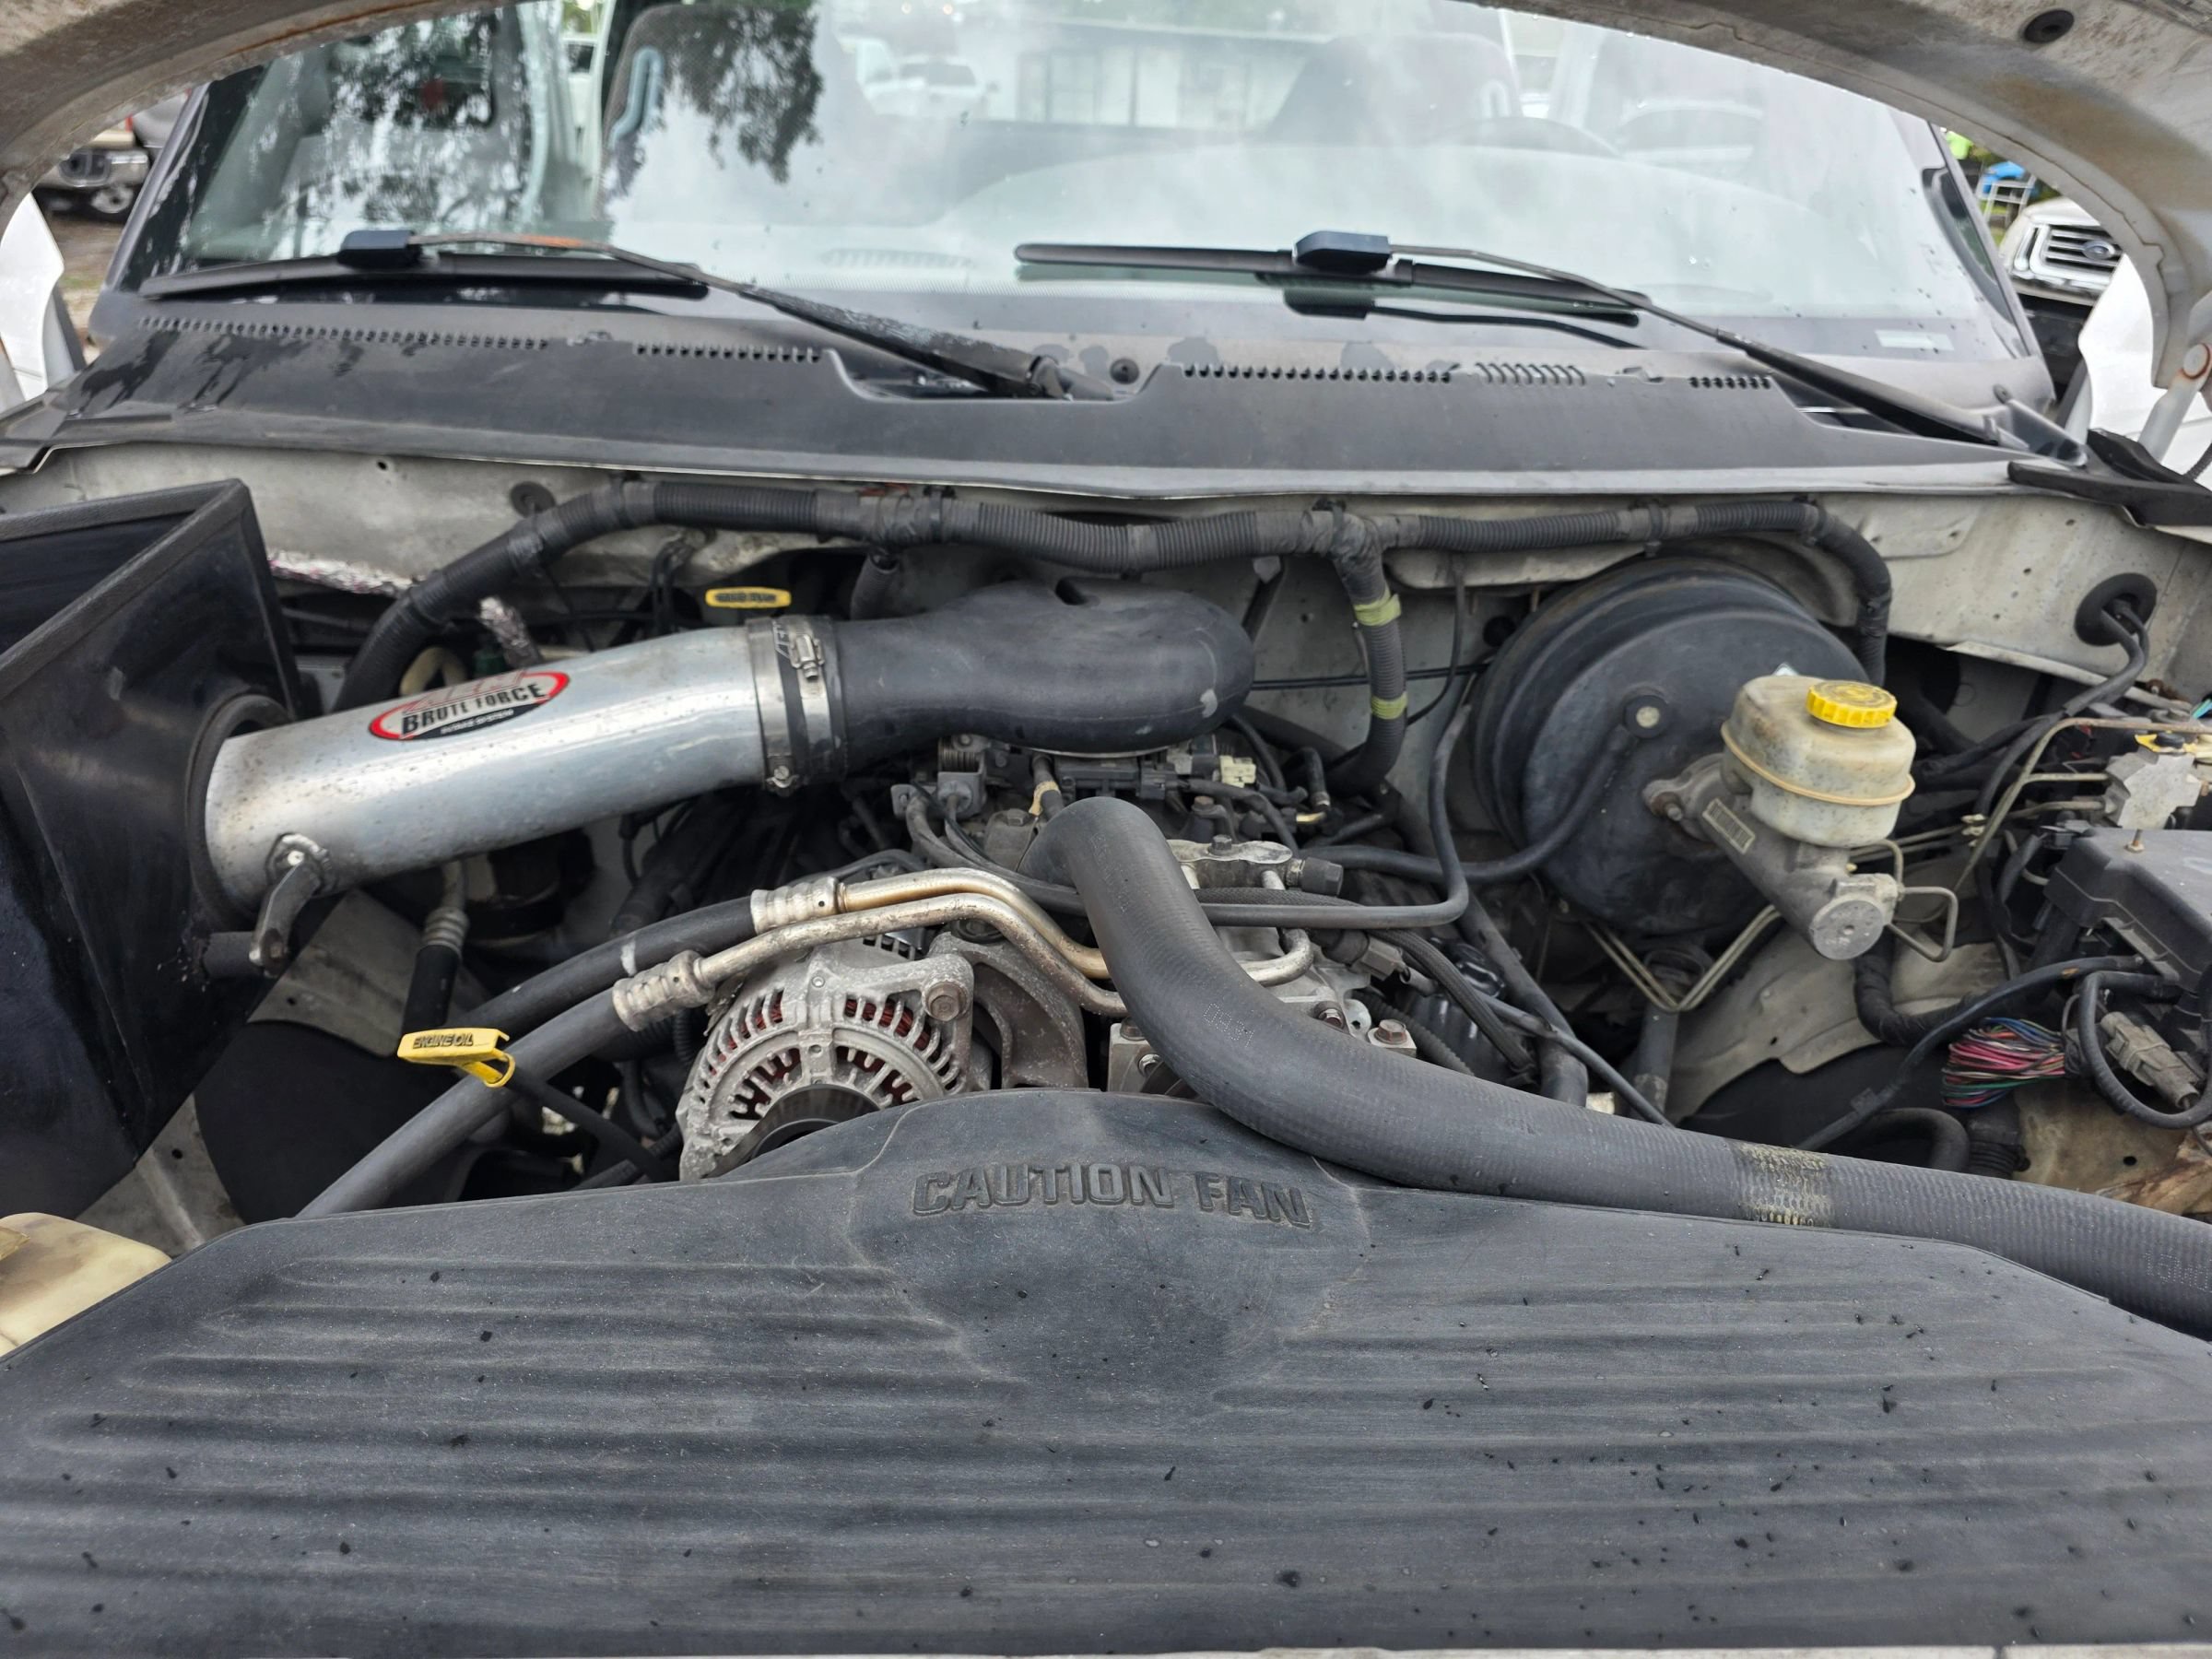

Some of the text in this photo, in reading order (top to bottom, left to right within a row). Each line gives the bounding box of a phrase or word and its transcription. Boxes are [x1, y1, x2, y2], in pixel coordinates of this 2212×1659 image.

[403, 684, 546, 735] BRUTE FORCE
[413, 1033, 474, 1049] ENGINE OIL
[912, 1162, 1312, 1230] CAUTION FAN
